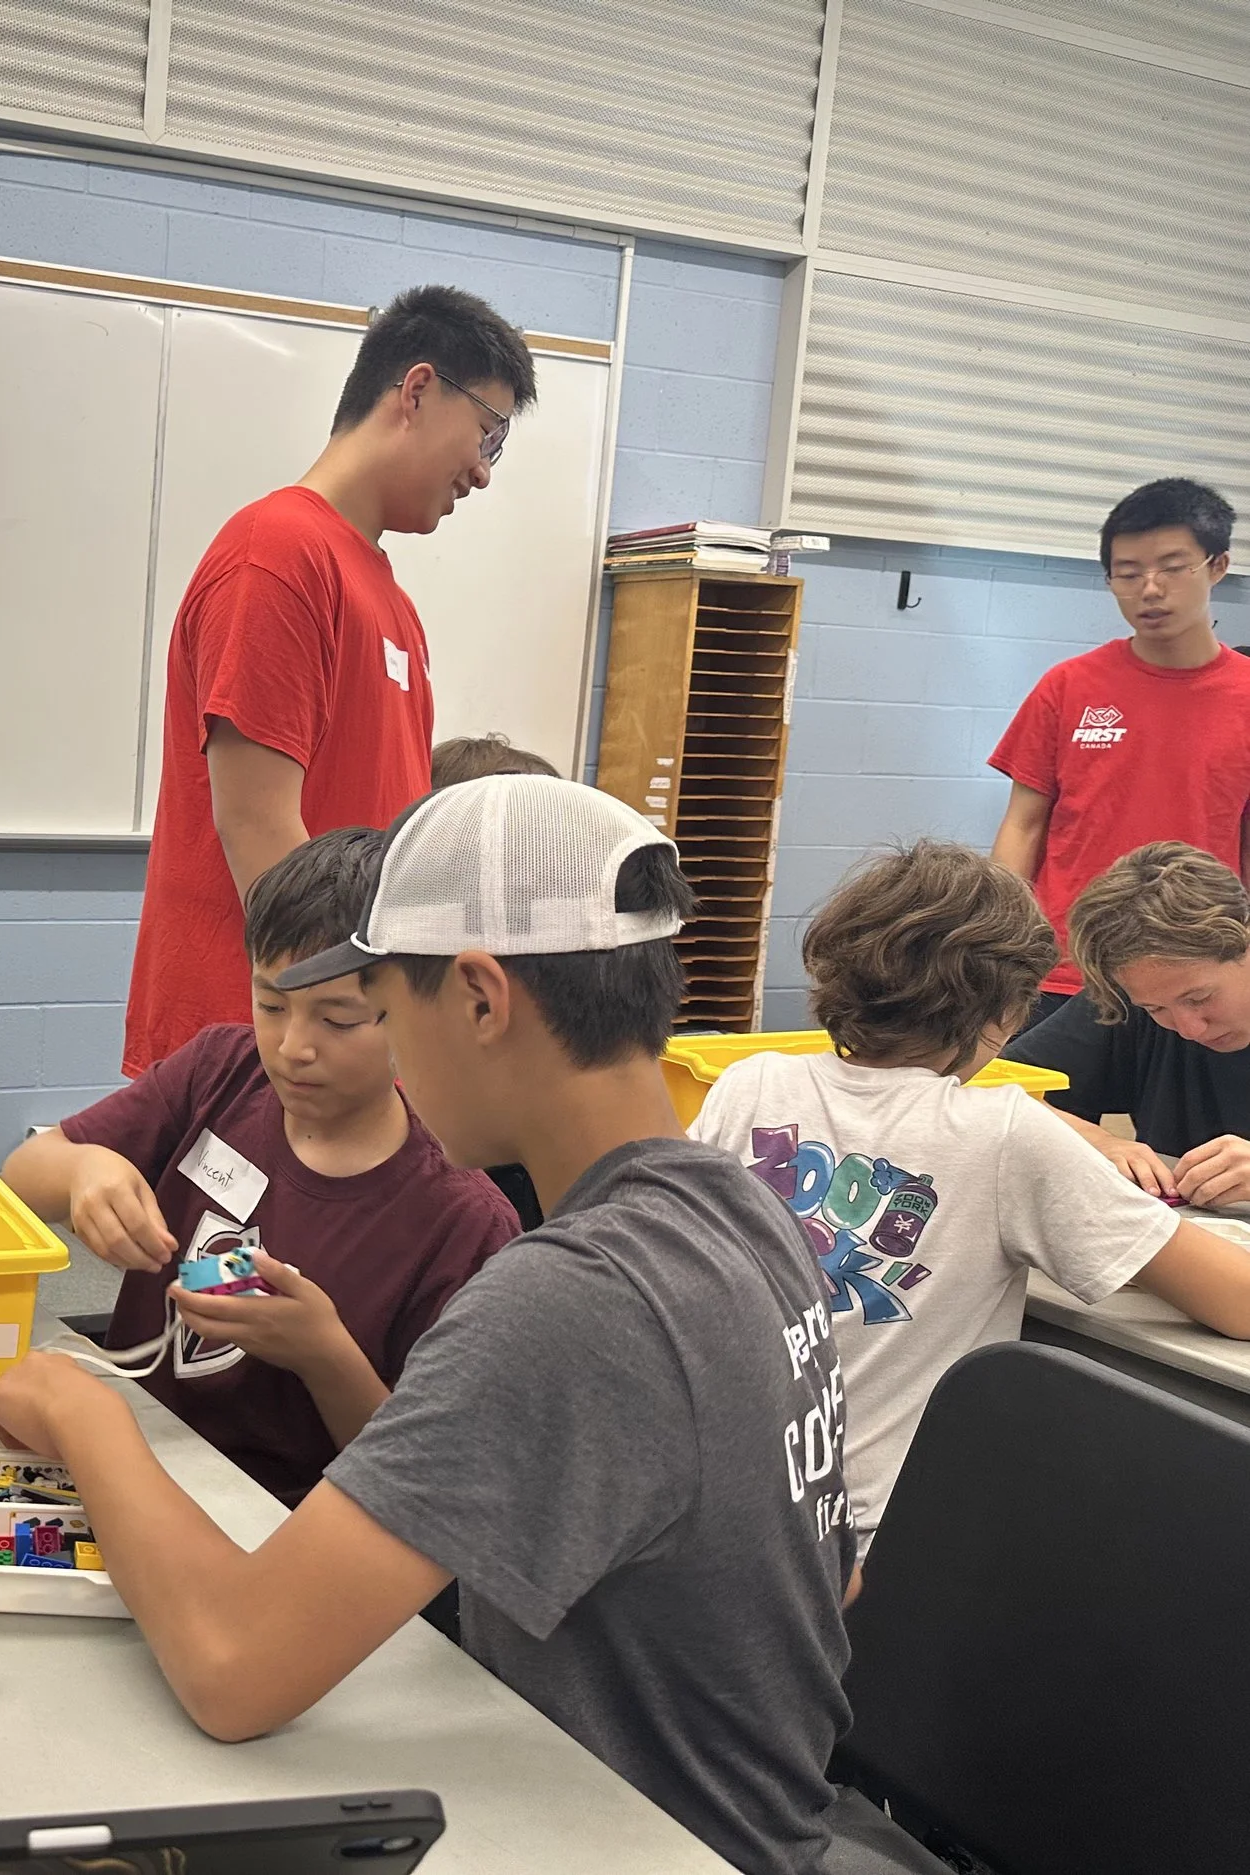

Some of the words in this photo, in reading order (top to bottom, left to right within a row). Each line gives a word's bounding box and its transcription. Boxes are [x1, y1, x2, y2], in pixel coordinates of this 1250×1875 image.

[1071, 728, 1127, 742] FIRST
[196, 1150, 234, 1188] Vincent
[893, 1200, 929, 1218] YORK
